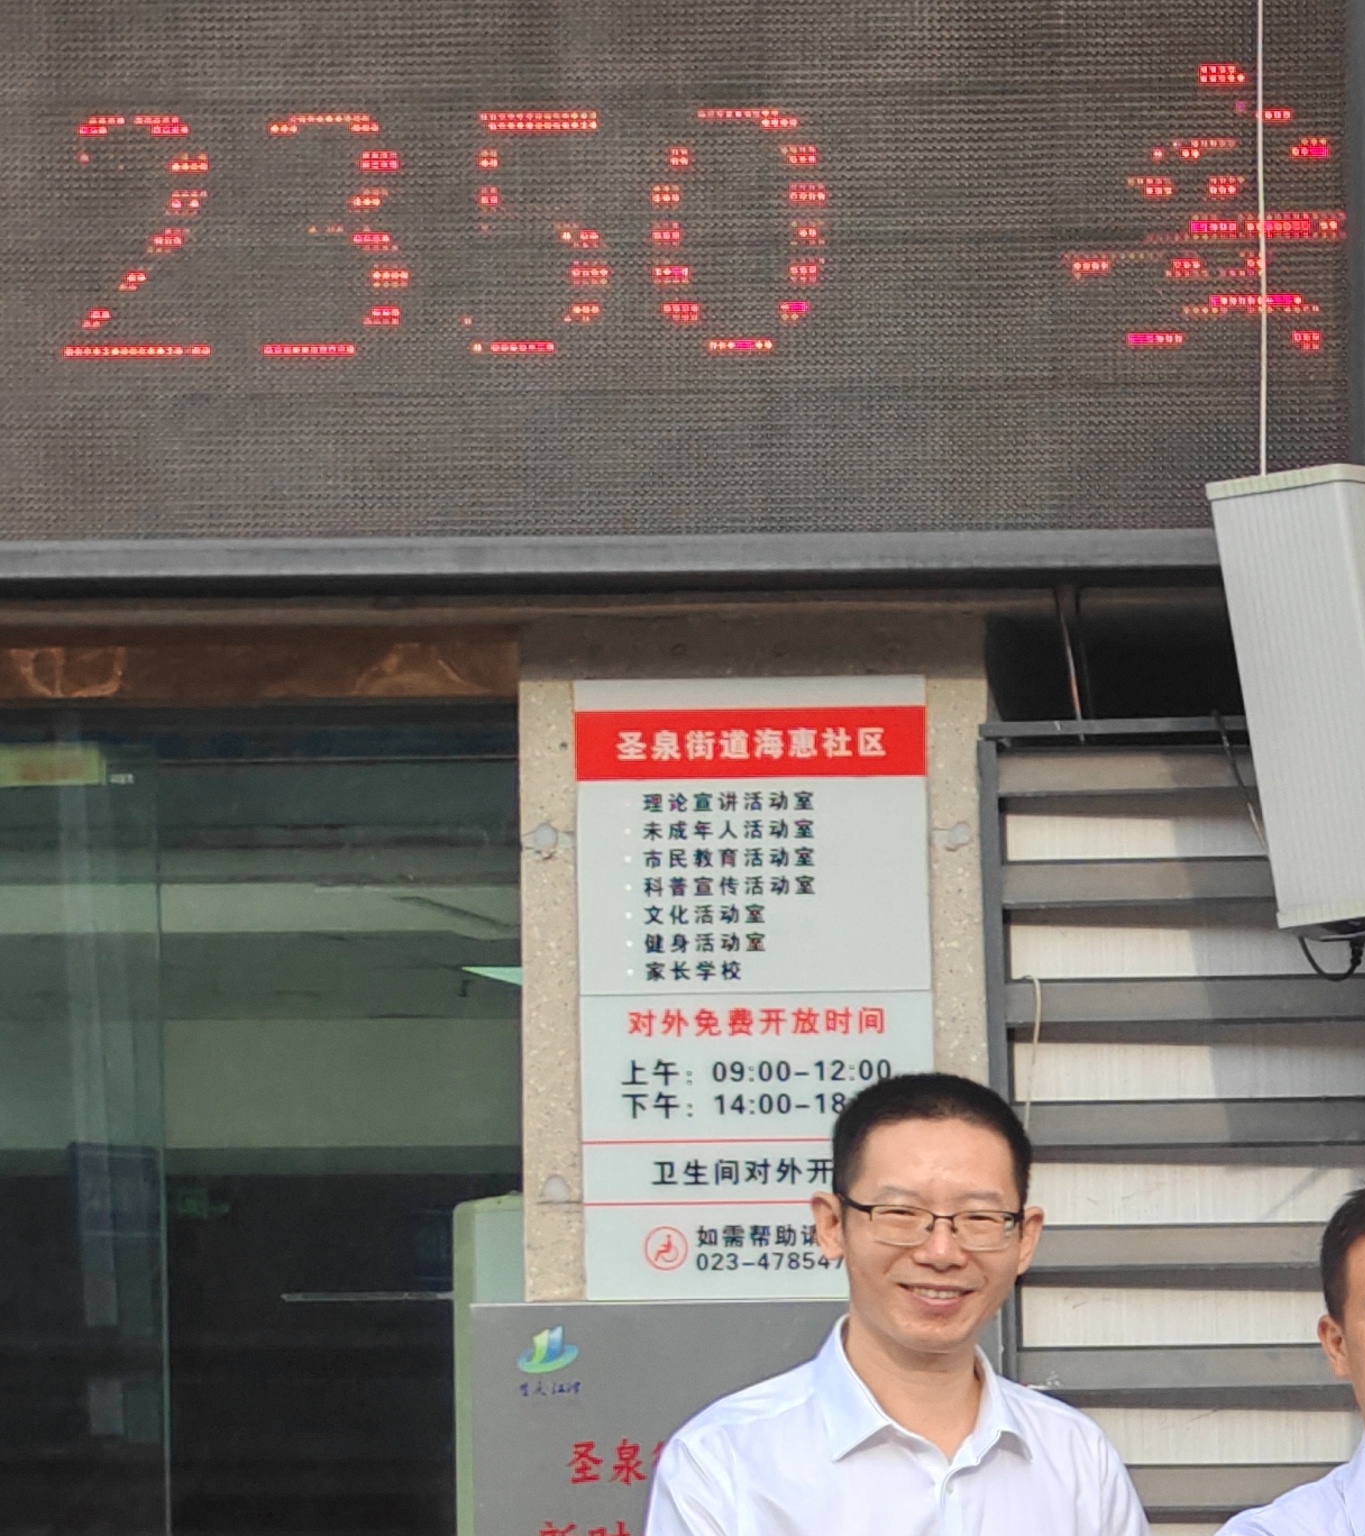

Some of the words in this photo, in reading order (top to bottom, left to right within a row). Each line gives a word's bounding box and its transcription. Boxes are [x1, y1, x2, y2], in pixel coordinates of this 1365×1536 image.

[62, 110, 830, 358] 2350
[616, 726, 886, 762] 圣泉街道海惠社区
[642, 790, 815, 813] 理论宣讲活动室
[642, 818, 816, 841] 未成年人活动室
[642, 846, 816, 869] 市民教育活动室
[643, 874, 816, 898] 科普宣传活动室
[643, 903, 767, 926] 文化活动室
[644, 932, 767, 955] 健身活动室
[645, 961, 743, 982] 家长学校
[627, 1007, 886, 1037] 对外免费开放时间
[566, 1437, 664, 1486] 圣泉
